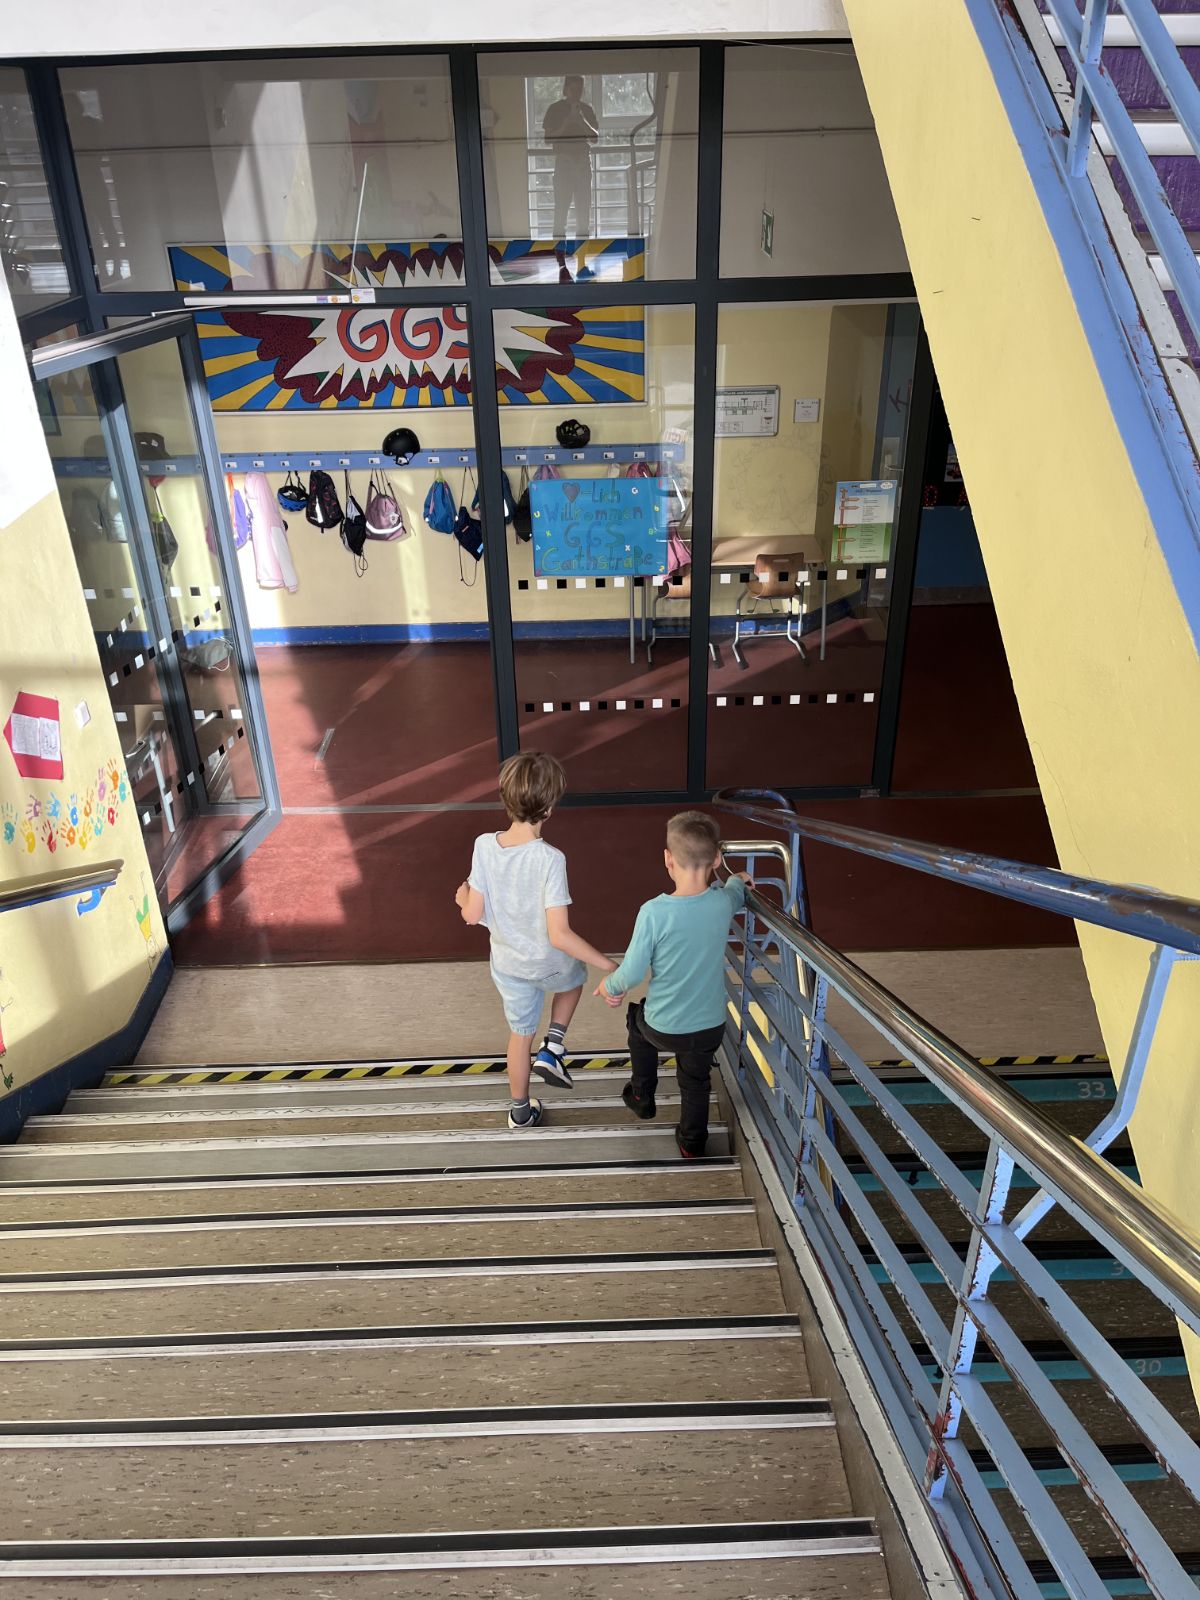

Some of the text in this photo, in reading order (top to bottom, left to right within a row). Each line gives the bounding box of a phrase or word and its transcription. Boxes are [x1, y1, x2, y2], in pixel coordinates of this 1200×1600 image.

[544, 503, 643, 522] Willkommen
[564, 521, 625, 549] GGS
[1077, 1081, 1106, 1099] 33
[1135, 1359, 1162, 1376] 30
